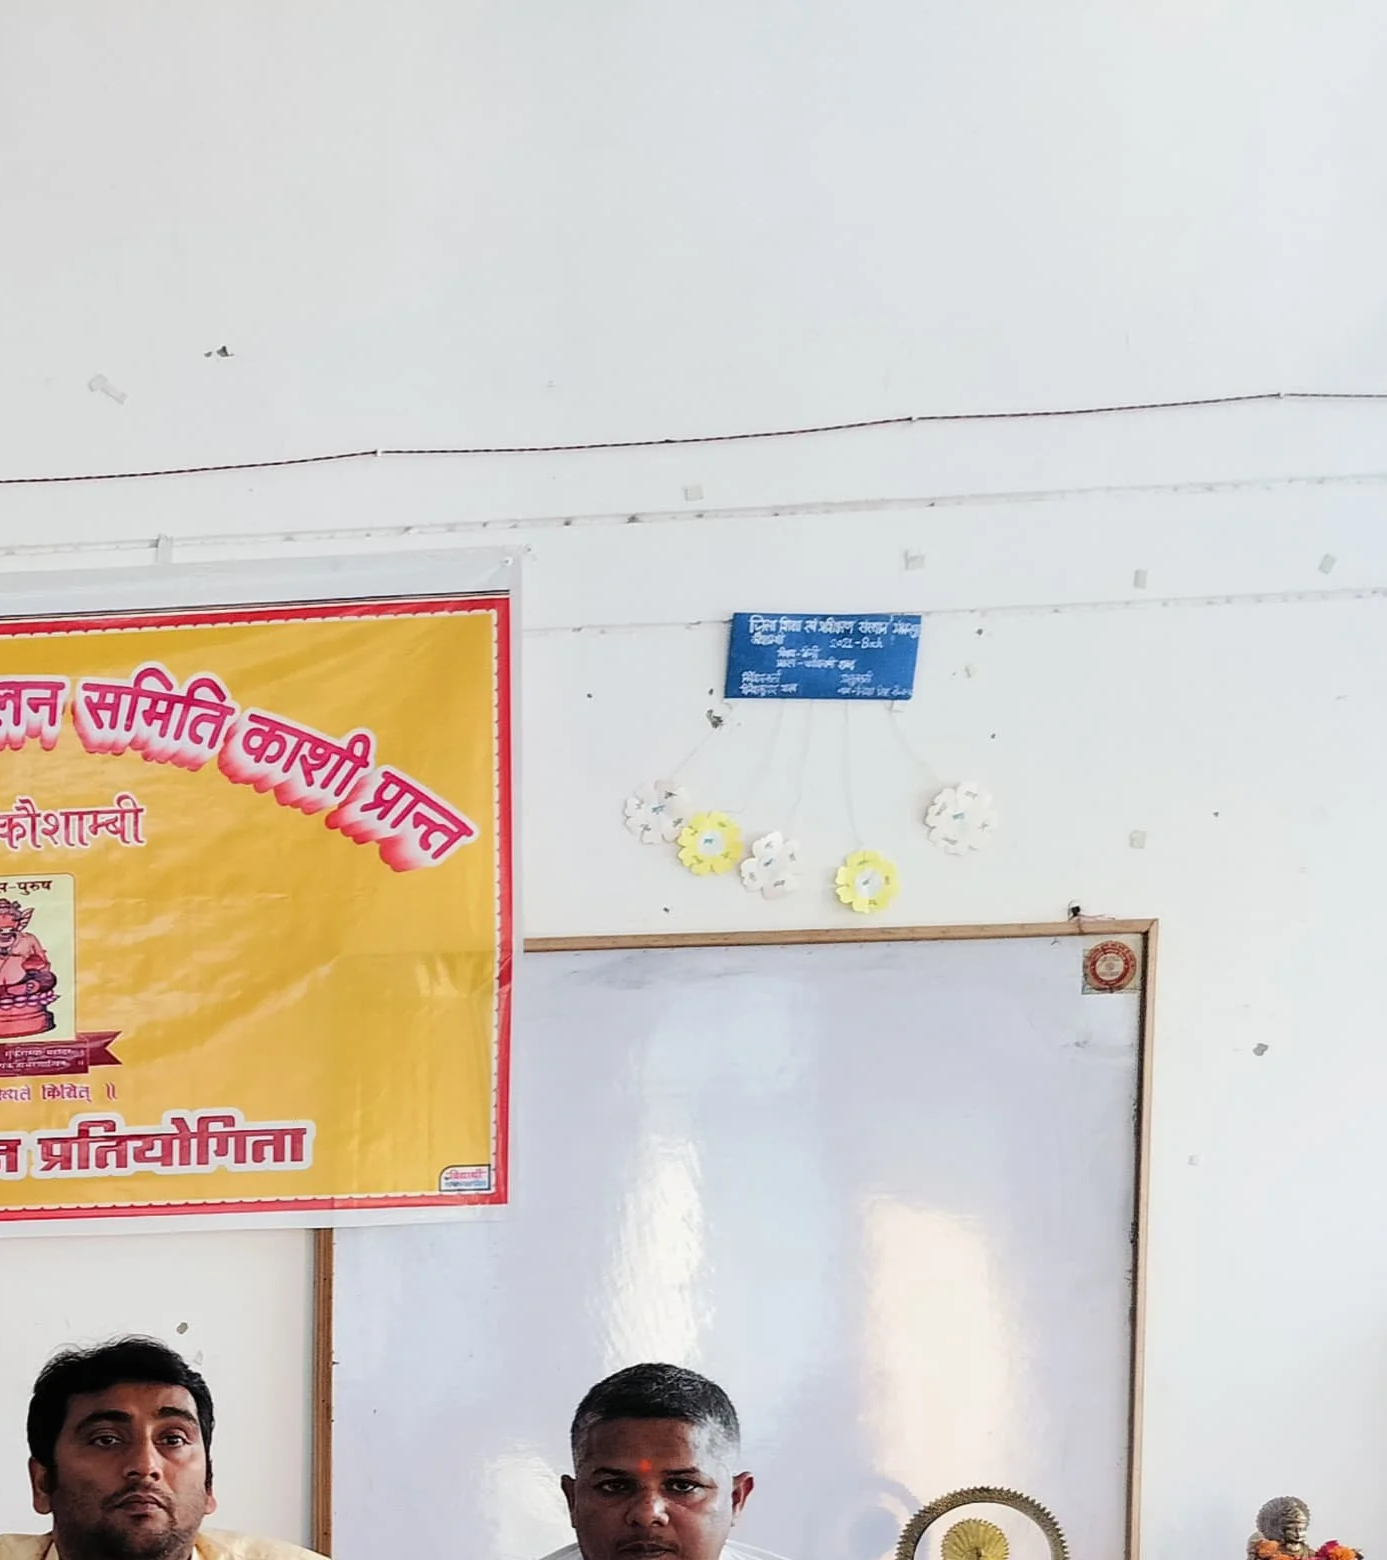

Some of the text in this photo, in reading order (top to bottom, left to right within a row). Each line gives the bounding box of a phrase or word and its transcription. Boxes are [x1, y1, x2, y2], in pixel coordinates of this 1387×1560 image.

[80, 665, 238, 756] समिति
[239, 711, 374, 800] काशी
[358, 768, 476, 863] प्रान्त
[35, 1114, 310, 1174] प्रतियोगिता
